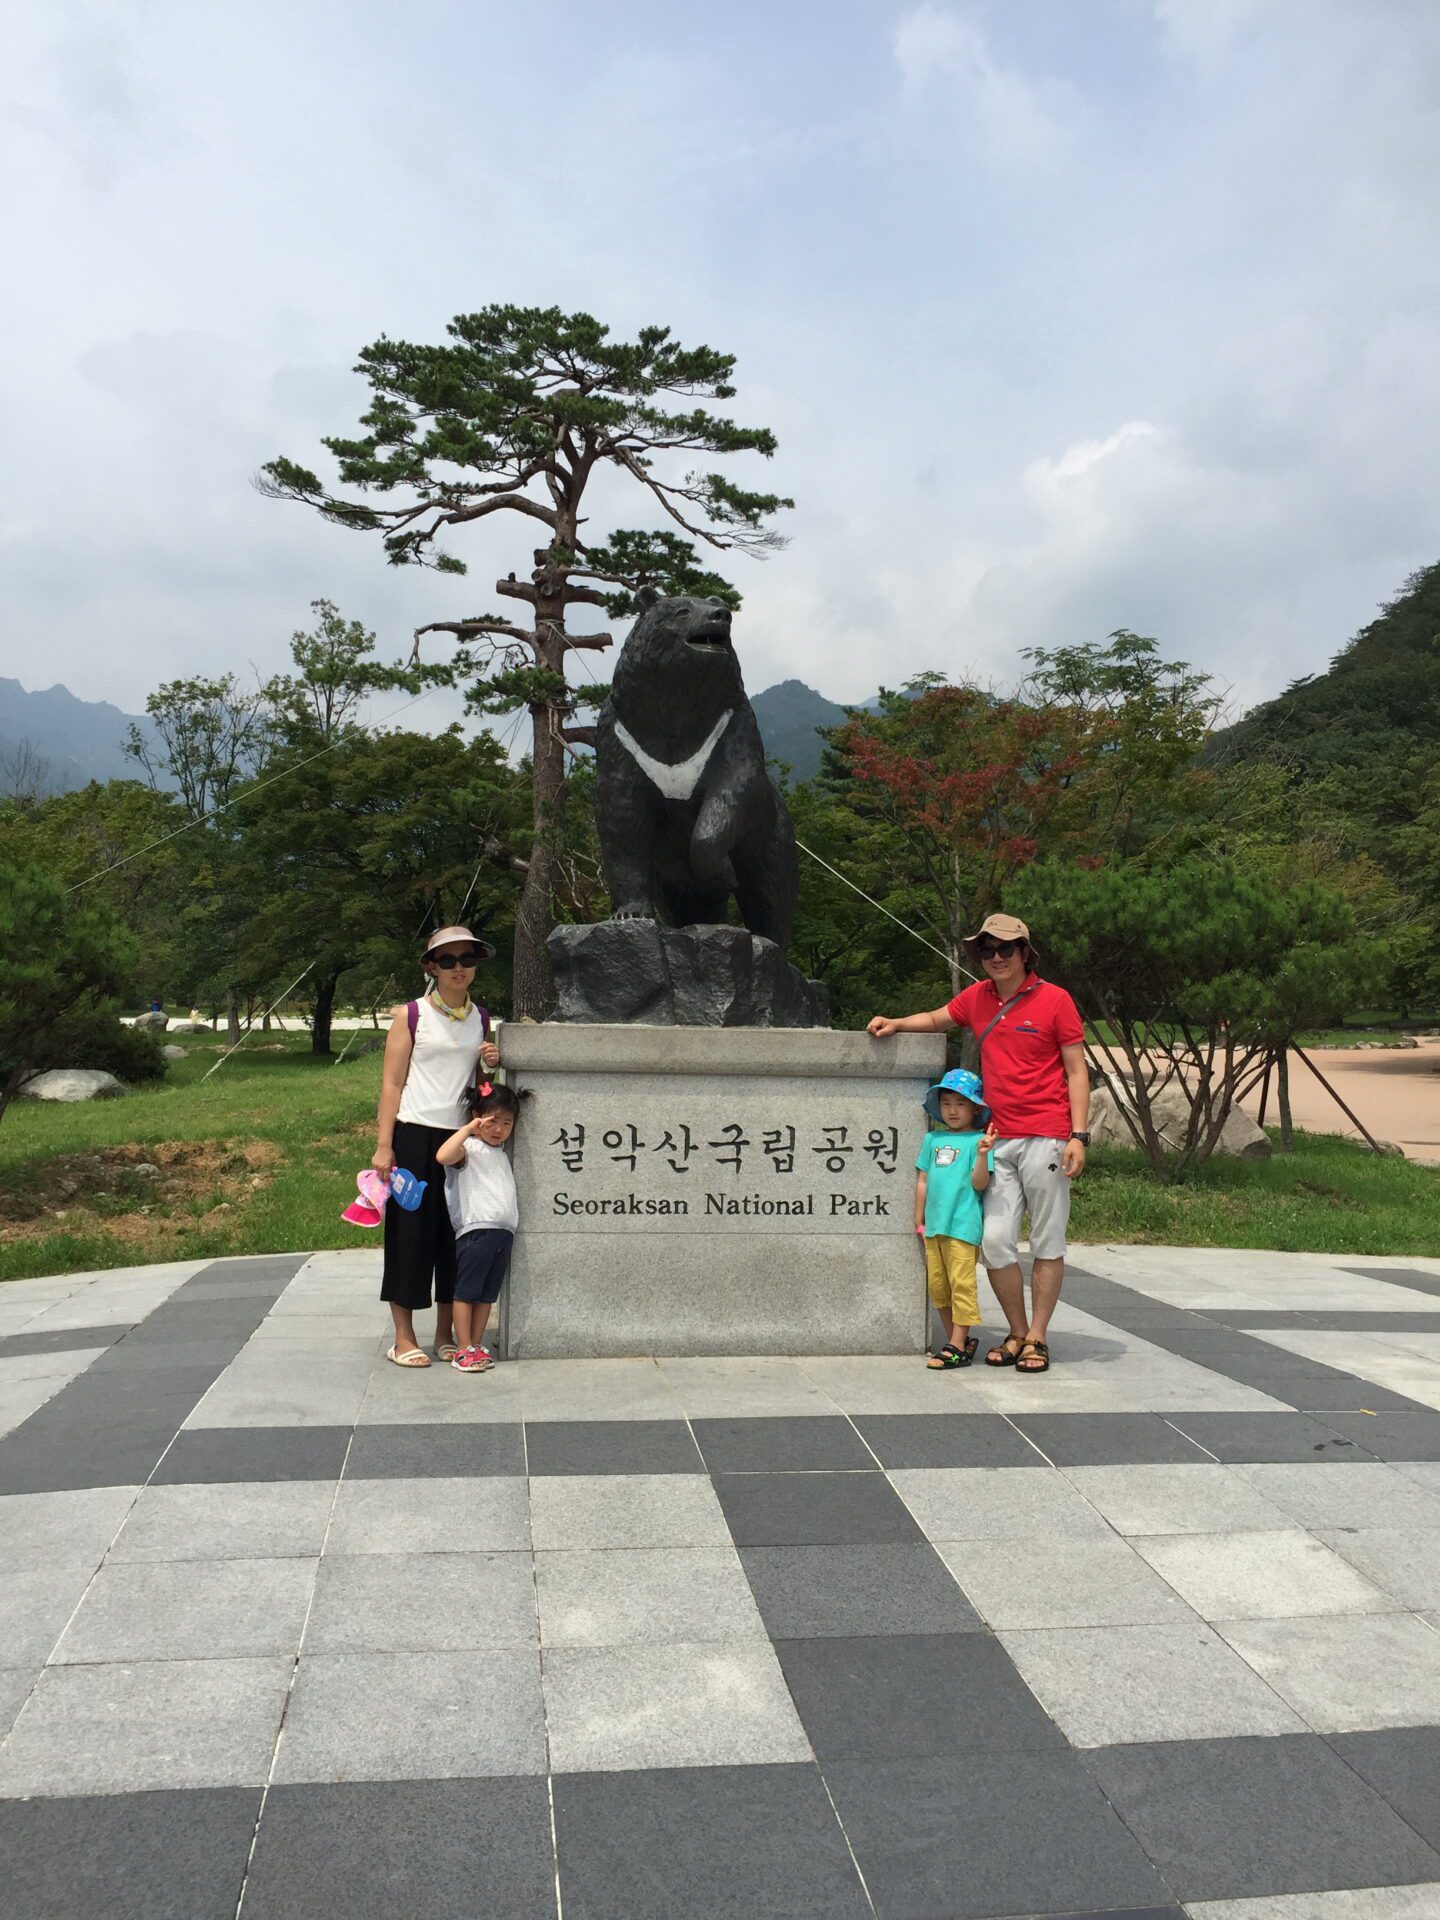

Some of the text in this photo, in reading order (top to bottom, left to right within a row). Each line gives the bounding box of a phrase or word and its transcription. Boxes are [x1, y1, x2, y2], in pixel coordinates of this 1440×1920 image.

[552, 1192, 890, 1216] Seoraksan National Park
